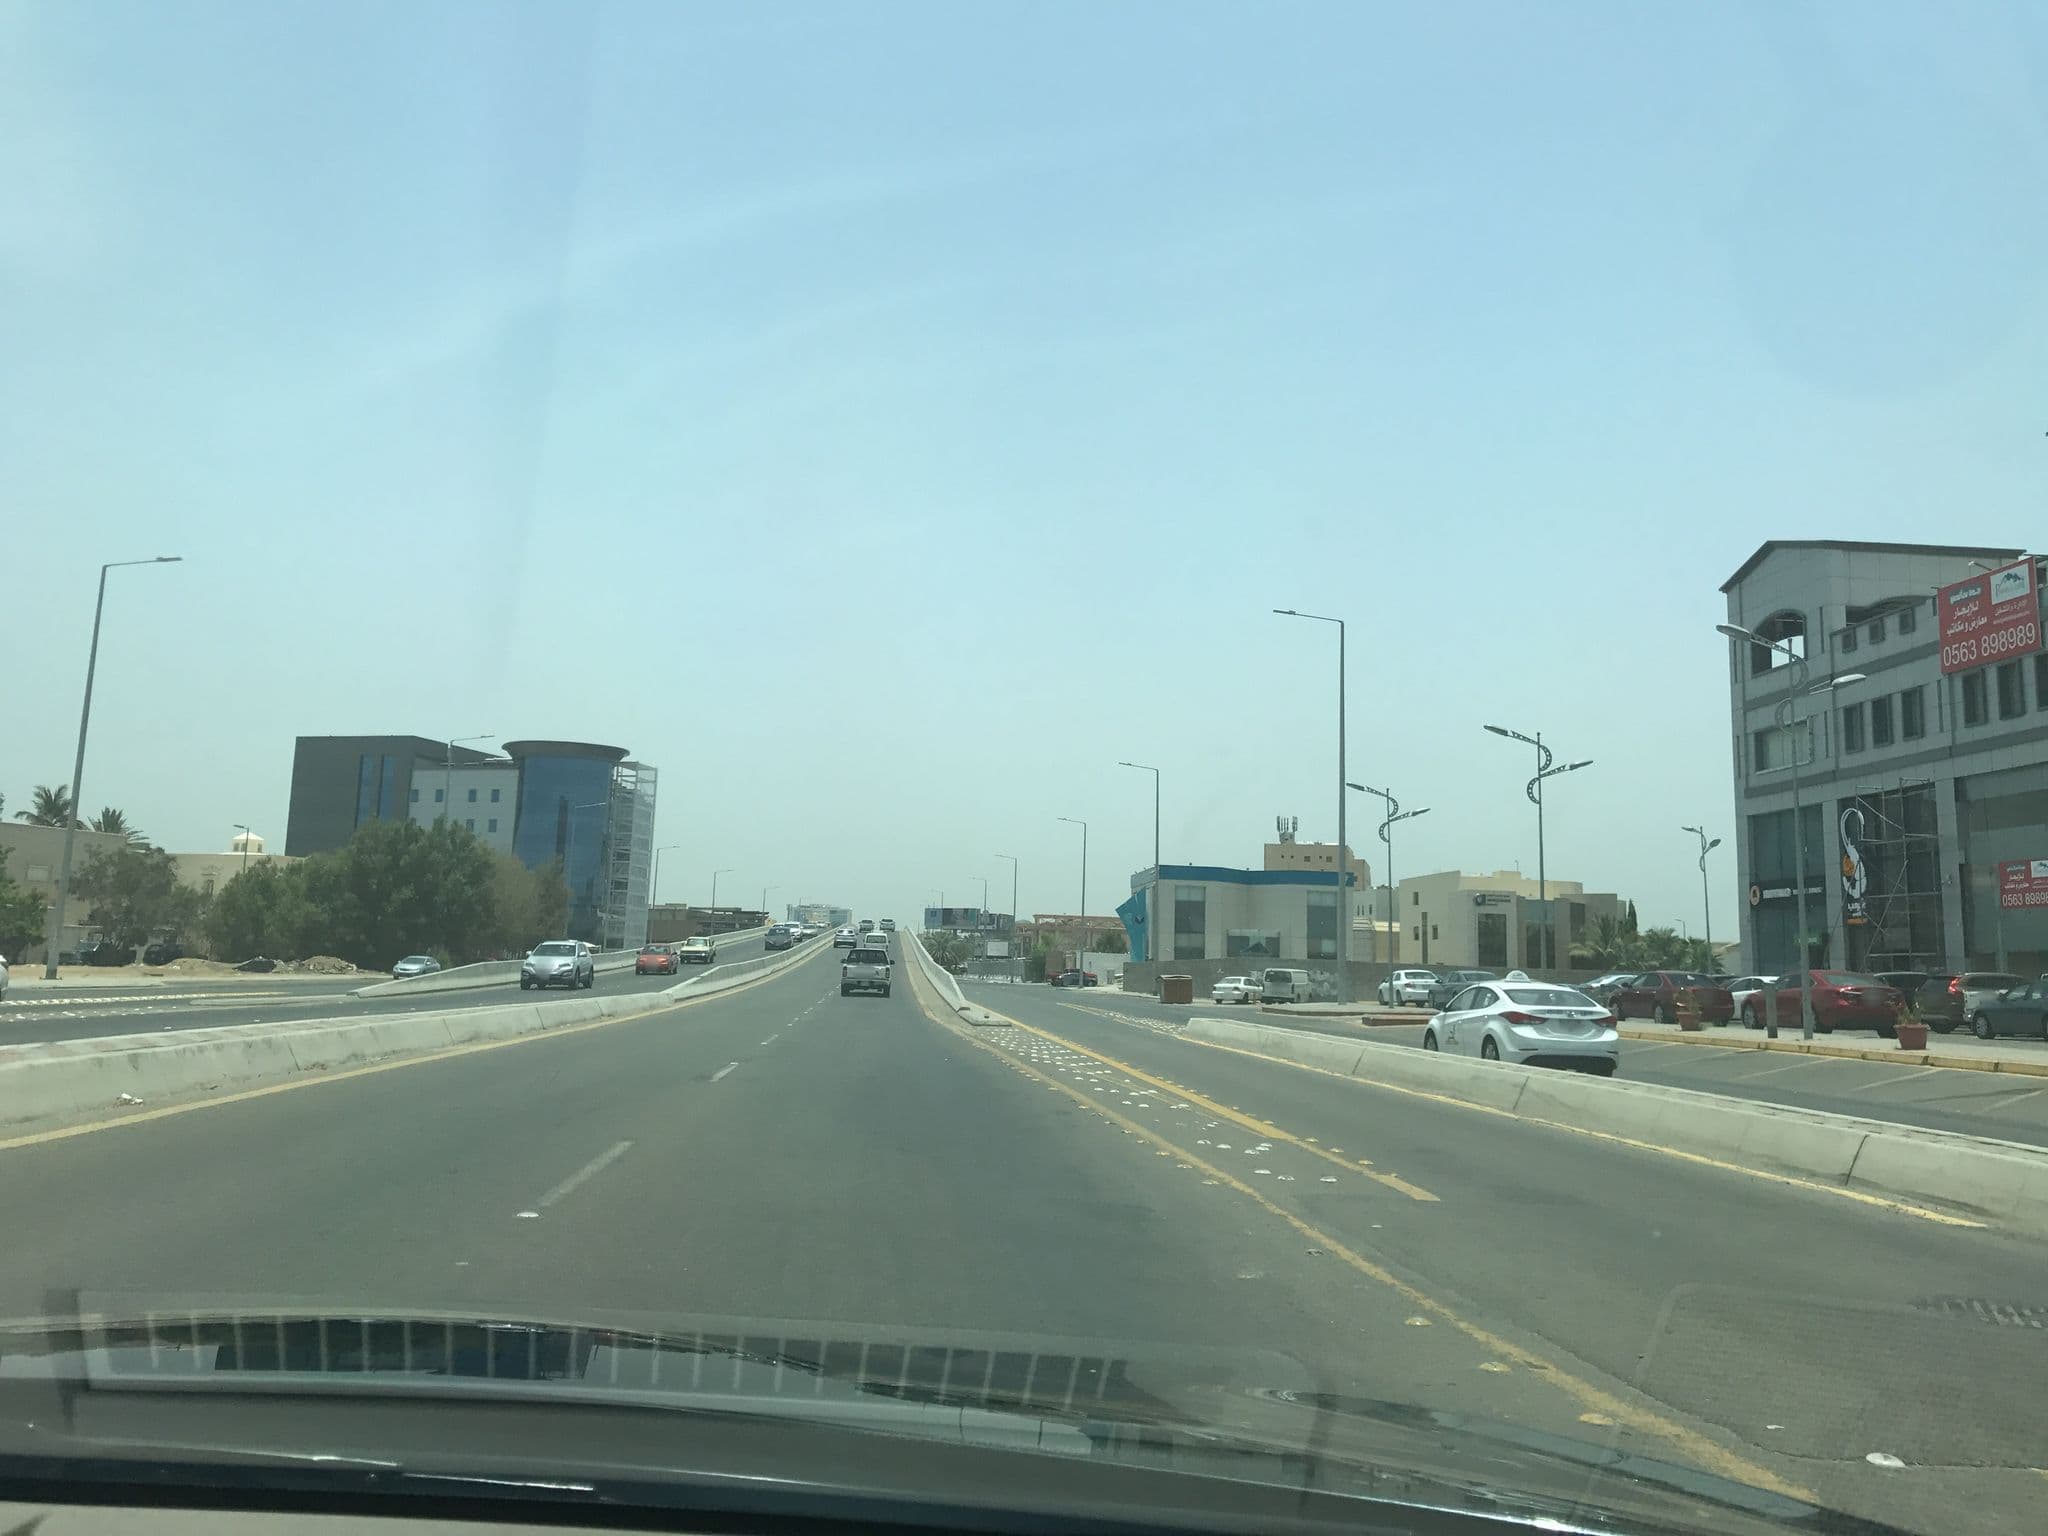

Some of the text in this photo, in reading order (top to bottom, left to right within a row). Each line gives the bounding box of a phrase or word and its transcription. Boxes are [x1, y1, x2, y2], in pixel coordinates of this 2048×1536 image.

[1943, 622, 2036, 666] 0563 898989
[2002, 893, 2023, 905] 0563
